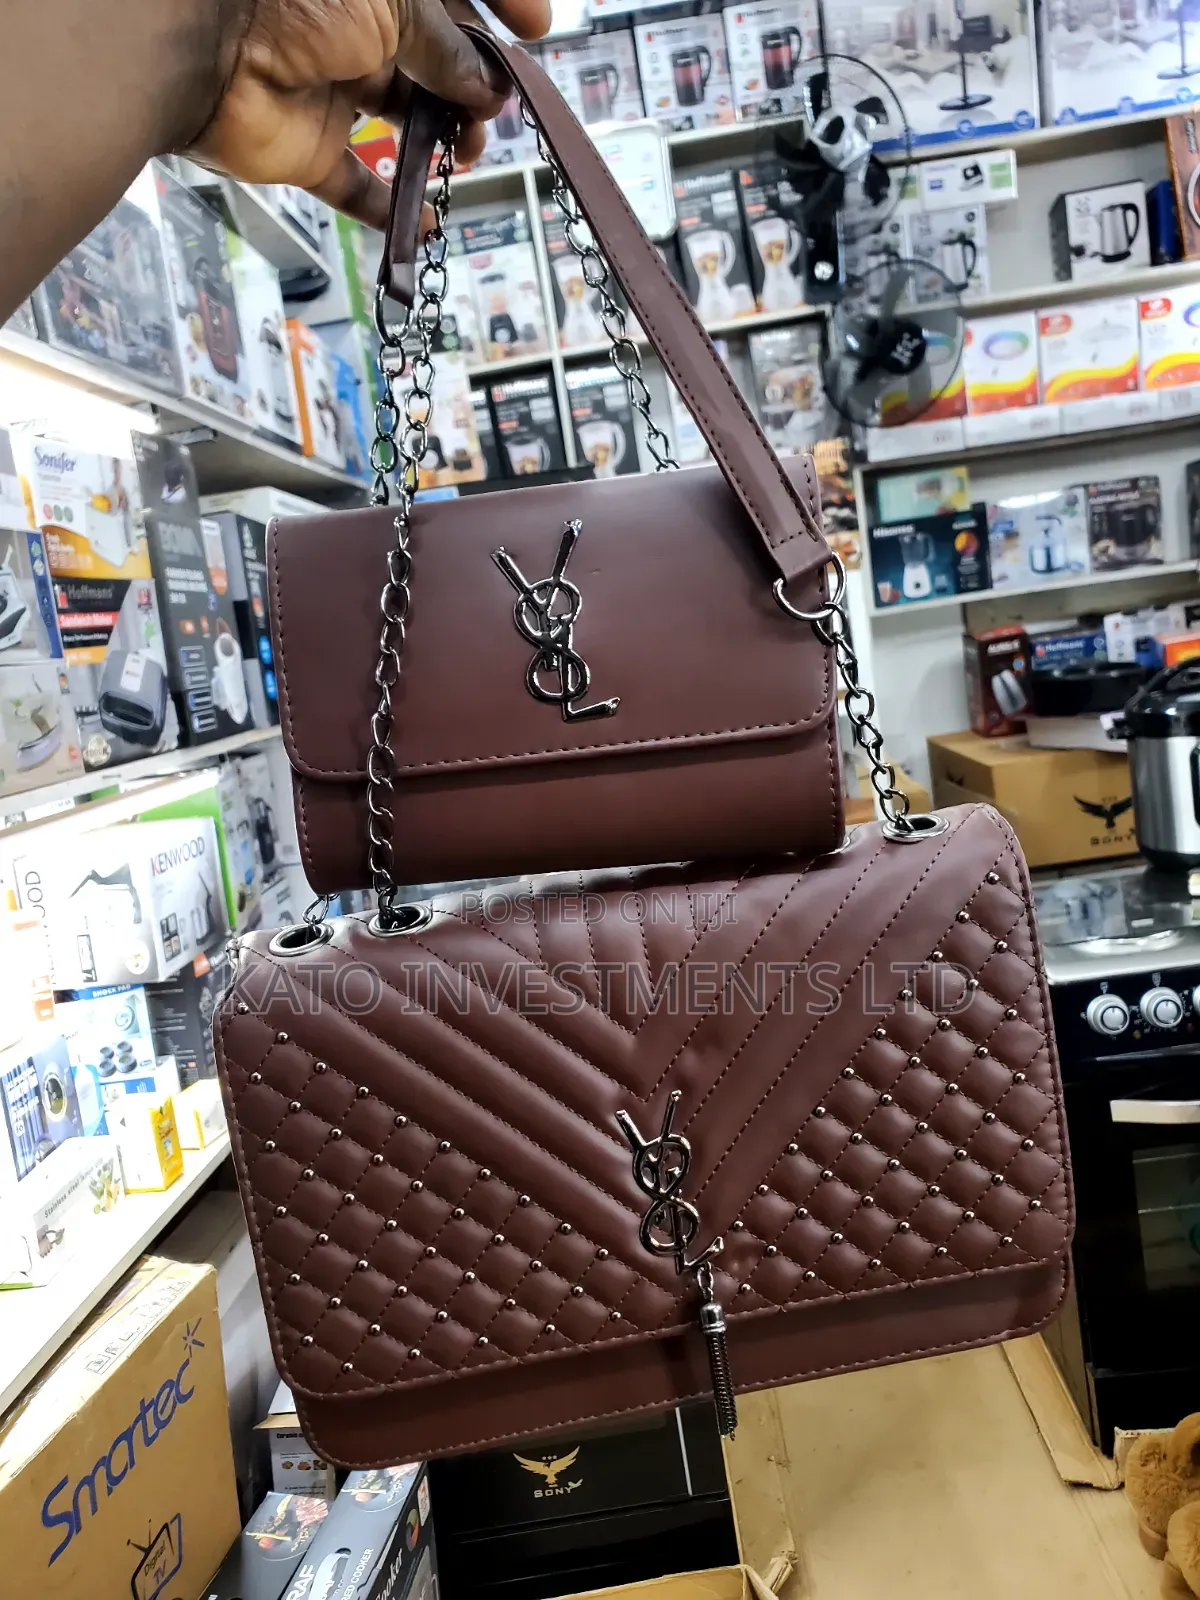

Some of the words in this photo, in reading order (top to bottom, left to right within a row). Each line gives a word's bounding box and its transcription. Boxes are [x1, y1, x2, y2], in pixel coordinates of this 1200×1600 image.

[150, 835, 206, 877] KENWOOD
[41, 1359, 196, 1568] Smartec
[533, 1486, 573, 1498] SONY
[143, 1540, 167, 1577] Digital
[350, 1548, 375, 1583] COOKER
